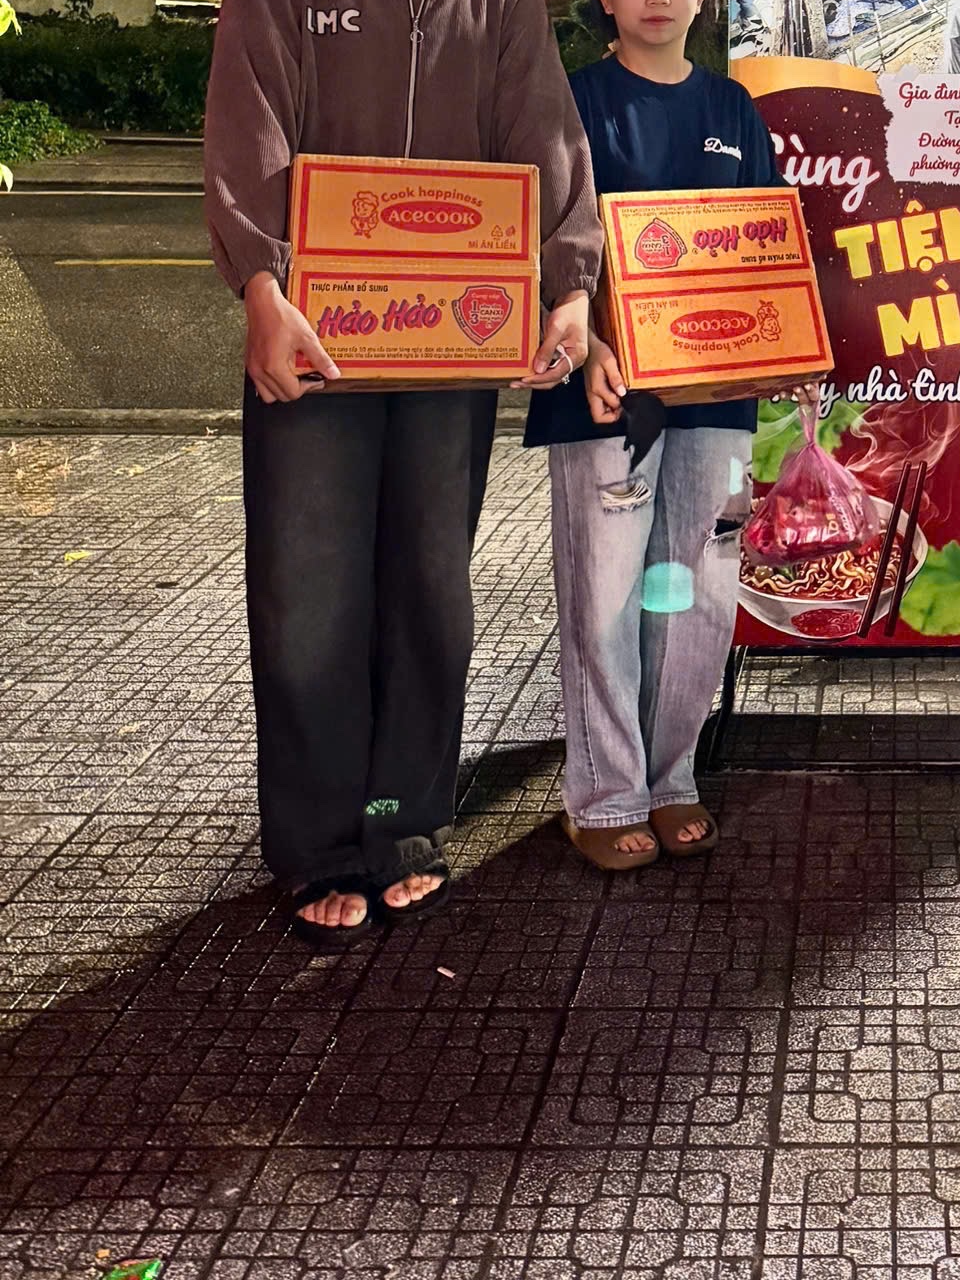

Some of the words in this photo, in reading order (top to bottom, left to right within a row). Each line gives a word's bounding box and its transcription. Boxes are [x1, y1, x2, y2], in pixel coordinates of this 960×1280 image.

[899, 81, 931, 108] Gia
[380, 187, 415, 202] Cook
[418, 186, 483, 208] happiness
[693, 224, 741, 258] Hảo
[742, 216, 789, 249] Hảo
[311, 283, 331, 292] THỰC
[332, 281, 354, 292] PHẨM
[357, 280, 367, 292] BỔ
[369, 284, 389, 293] SUNG
[316, 299, 379, 339] Hảo
[382, 293, 443, 333] Hảo
[672, 339, 730, 355] happiness
[733, 333, 760, 351] Cook
[847, 366, 908, 404] nhà
